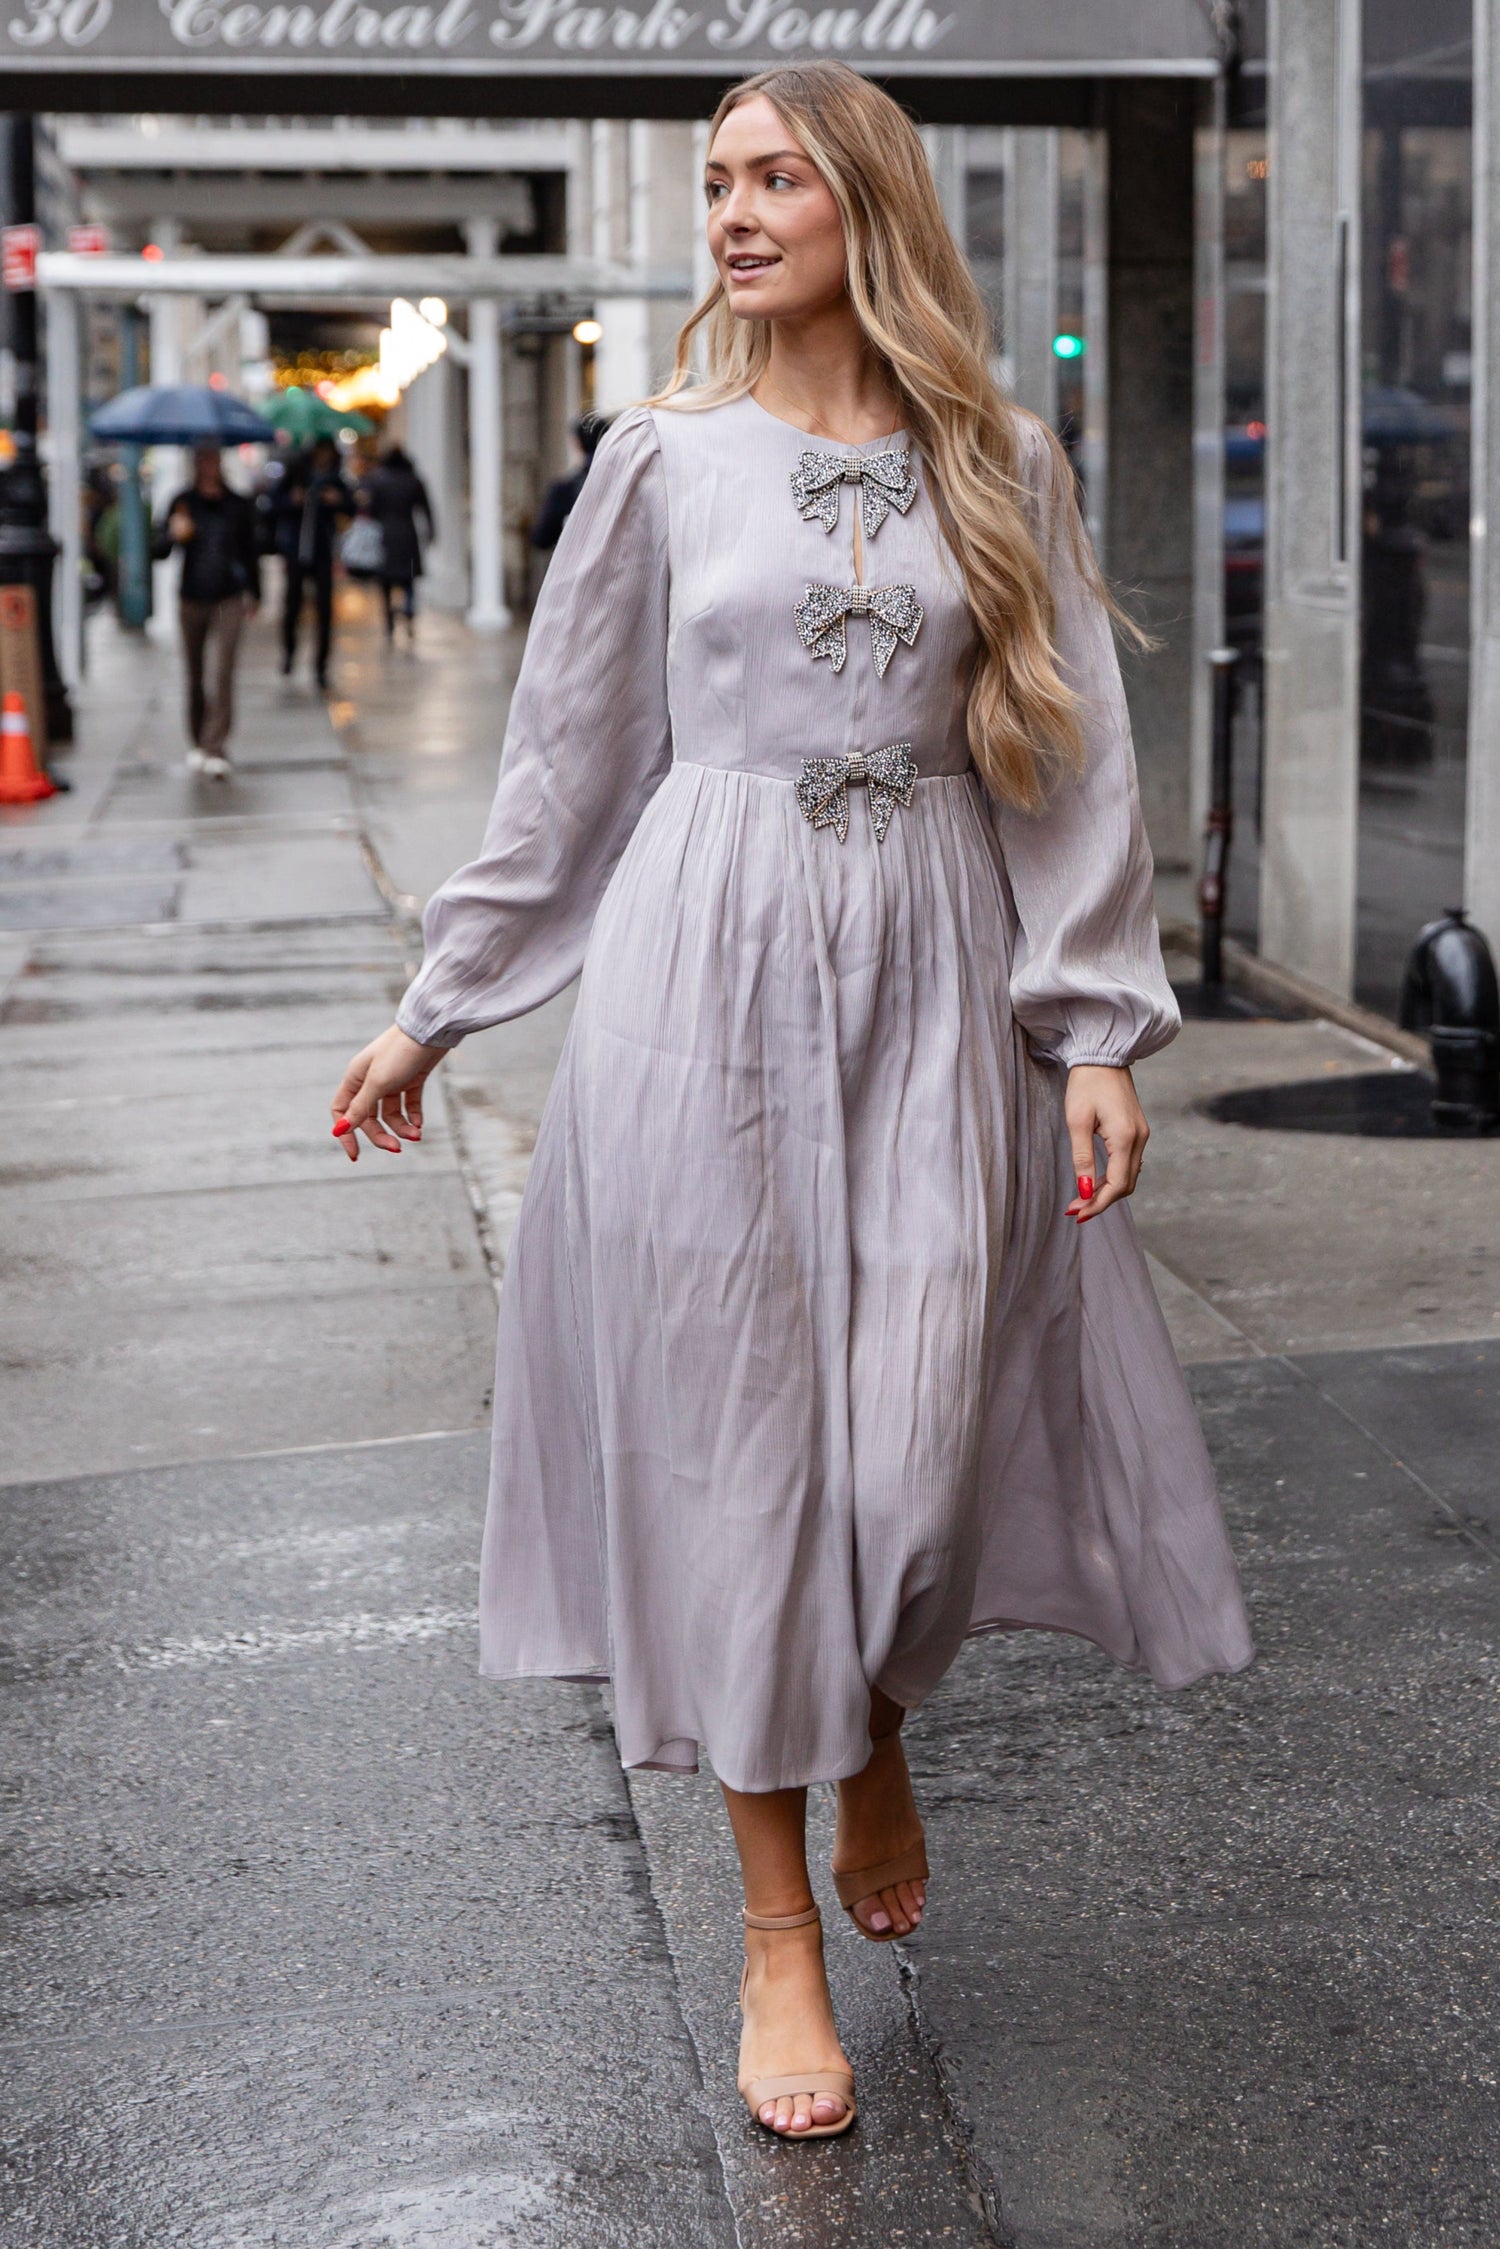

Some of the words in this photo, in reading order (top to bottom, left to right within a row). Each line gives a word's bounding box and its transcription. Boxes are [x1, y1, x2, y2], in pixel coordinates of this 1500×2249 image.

[157, 0, 481, 49] Central
[488, 0, 701, 50] Park
[706, 0, 956, 50] South
